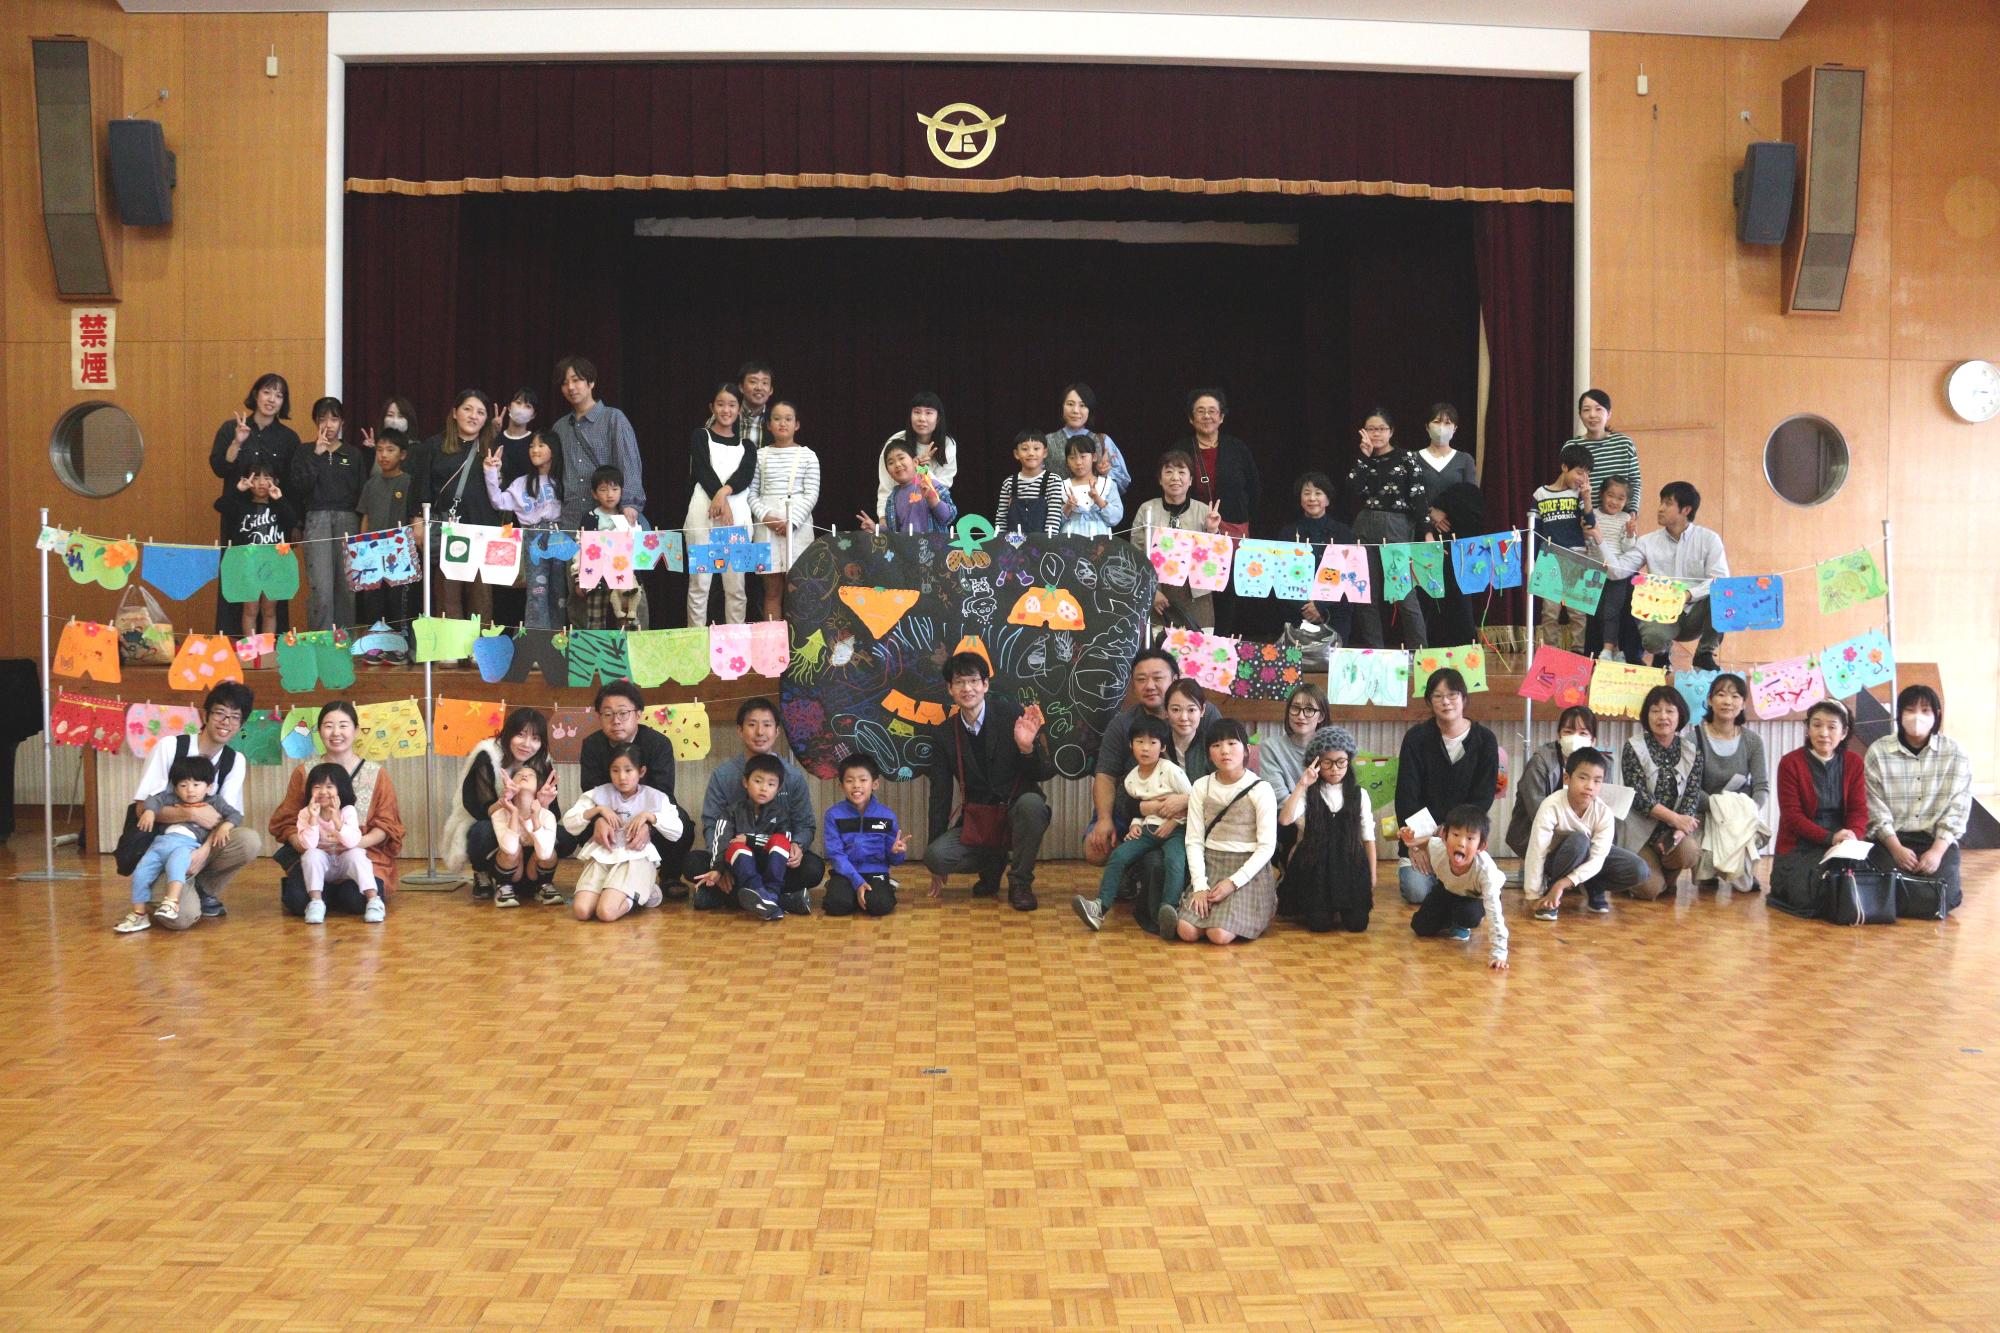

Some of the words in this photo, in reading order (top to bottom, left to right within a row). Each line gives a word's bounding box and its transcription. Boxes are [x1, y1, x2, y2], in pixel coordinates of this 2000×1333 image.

[80, 314, 108, 383] 禁煙
[240, 507, 277, 532] Little
[248, 525, 285, 545] Dolly
